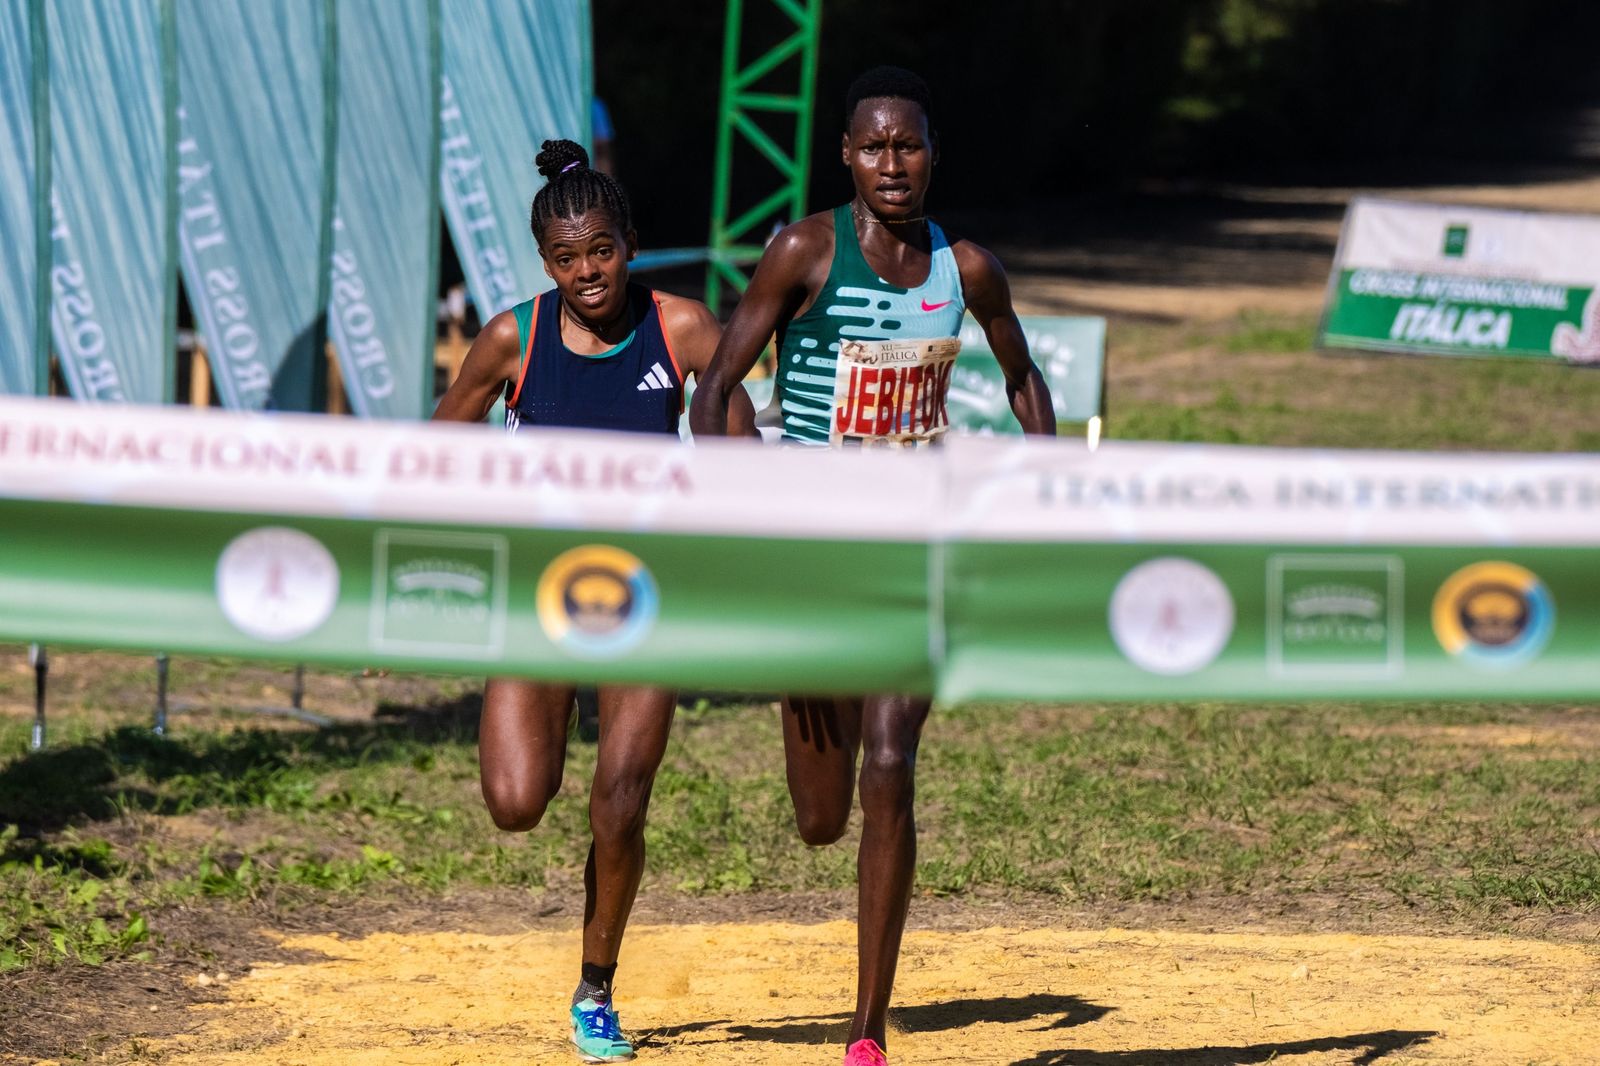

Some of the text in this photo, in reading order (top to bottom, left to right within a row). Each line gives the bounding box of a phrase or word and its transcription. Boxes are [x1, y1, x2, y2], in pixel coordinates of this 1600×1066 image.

[1388, 299, 1513, 348] ITÁLICA
[836, 359, 955, 436] JEBITOK
[387, 445, 457, 482] DE
